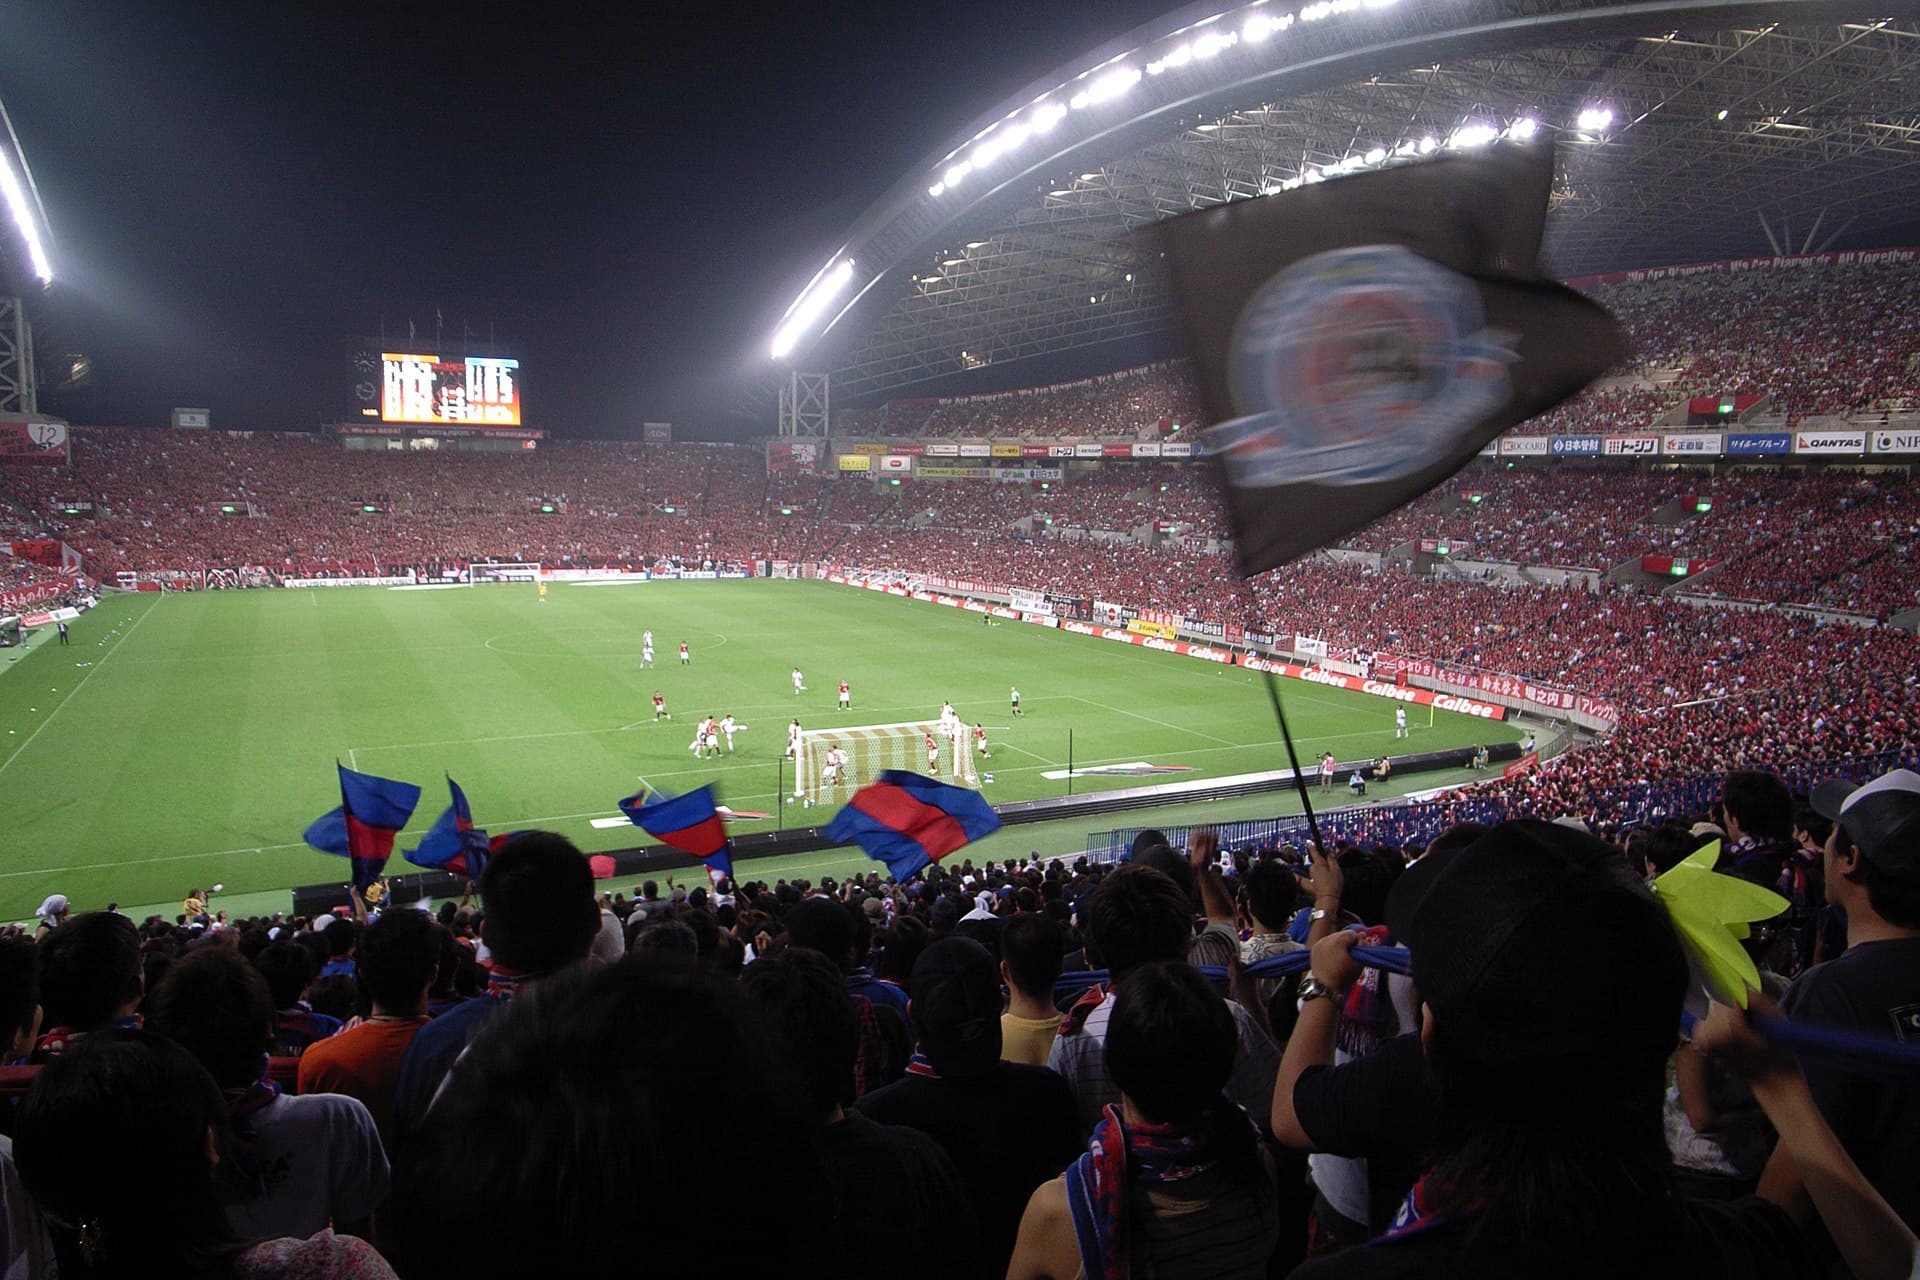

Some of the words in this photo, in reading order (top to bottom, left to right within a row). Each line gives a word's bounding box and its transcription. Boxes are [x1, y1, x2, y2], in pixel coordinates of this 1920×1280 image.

[38, 426, 56, 445] 12
[1810, 438, 1863, 448] QANTAS
[1621, 439, 1654, 453] トーシン
[992, 606, 1016, 619] Calbee
[1065, 621, 1094, 635] Calbee
[1102, 628, 1134, 643] Calbee
[1143, 637, 1178, 652] Calbee
[1188, 646, 1225, 662] Calbee
[1243, 655, 1287, 675] Calbee
[1299, 667, 1348, 688] Calbee
[1362, 680, 1416, 701] Calbee
[1433, 694, 1494, 718] Calbee
